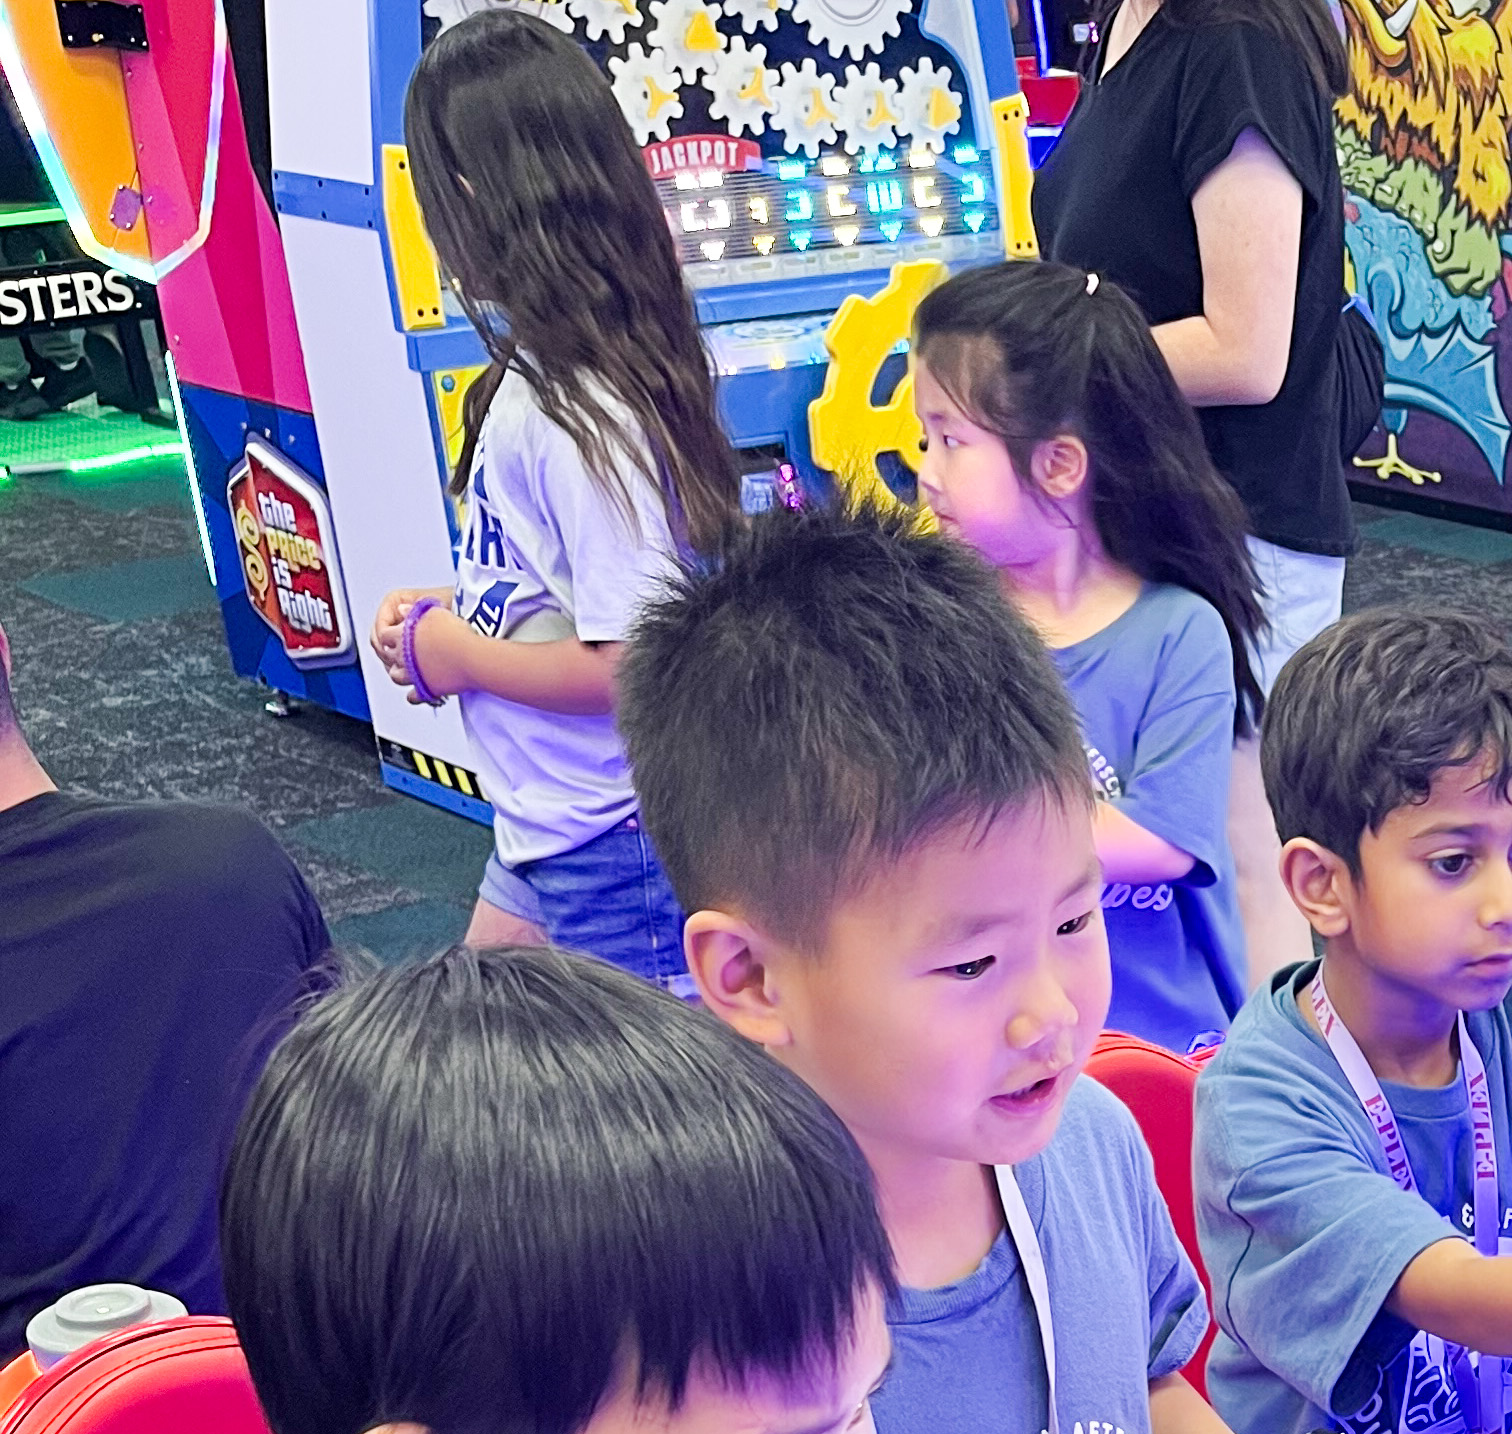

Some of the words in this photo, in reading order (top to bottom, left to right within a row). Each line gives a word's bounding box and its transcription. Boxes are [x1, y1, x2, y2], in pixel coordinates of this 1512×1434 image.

[651, 140, 738, 175] JACKPOT
[258, 491, 297, 533] the
[271, 556, 292, 588] is
[1470, 1071, 1495, 1179] E-PLEX
